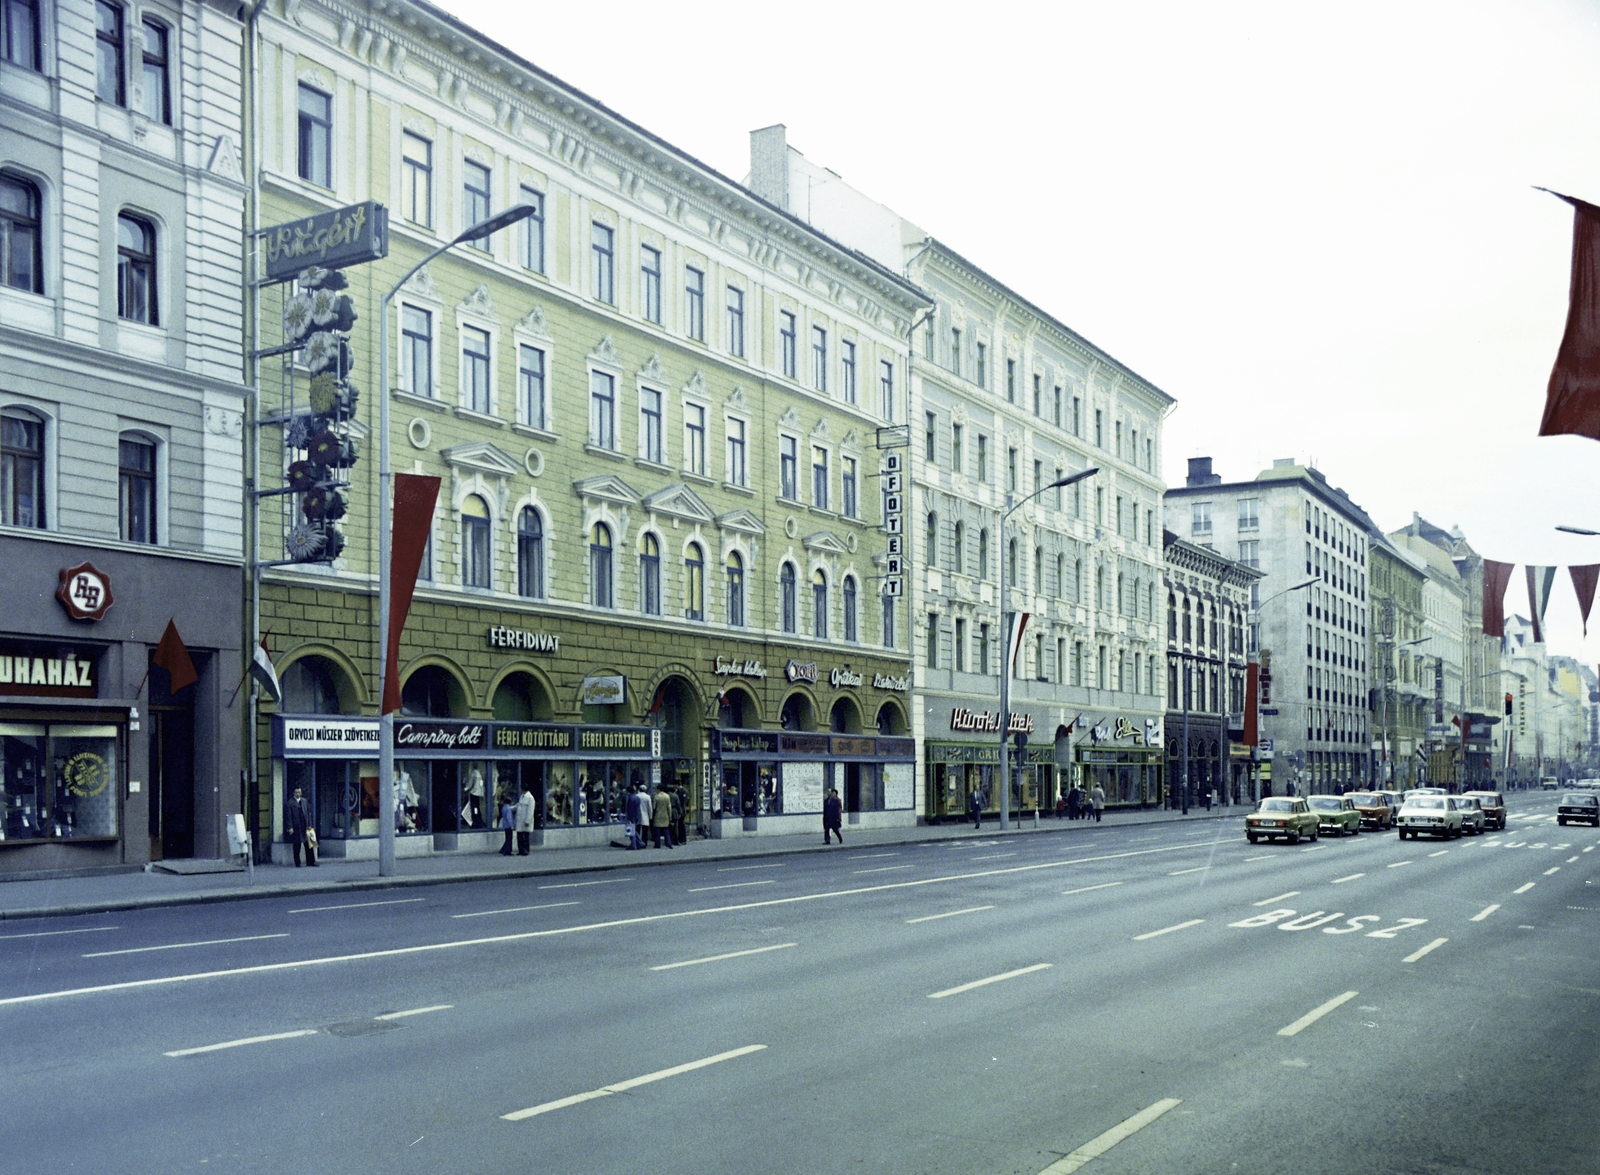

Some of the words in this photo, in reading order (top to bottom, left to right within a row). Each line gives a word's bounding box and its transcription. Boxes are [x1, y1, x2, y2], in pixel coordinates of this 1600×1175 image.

[489, 625, 560, 652] FÉRFIDIVAT
[289, 728, 314, 741] ORVOSI
[344, 727, 380, 742] SZÖVETKEZE
[398, 724, 455, 748] Camping
[457, 725, 483, 745] bolt
[497, 728, 520, 746] FÉRFI
[522, 729, 569, 747] KÖTÖTTÁRU
[582, 731, 602, 748] FÉRFI
[604, 731, 646, 748] KÖTÖTTÁRU
[1480, 841, 1572, 849] BUSZ
[1228, 908, 1428, 939] BUSZ
